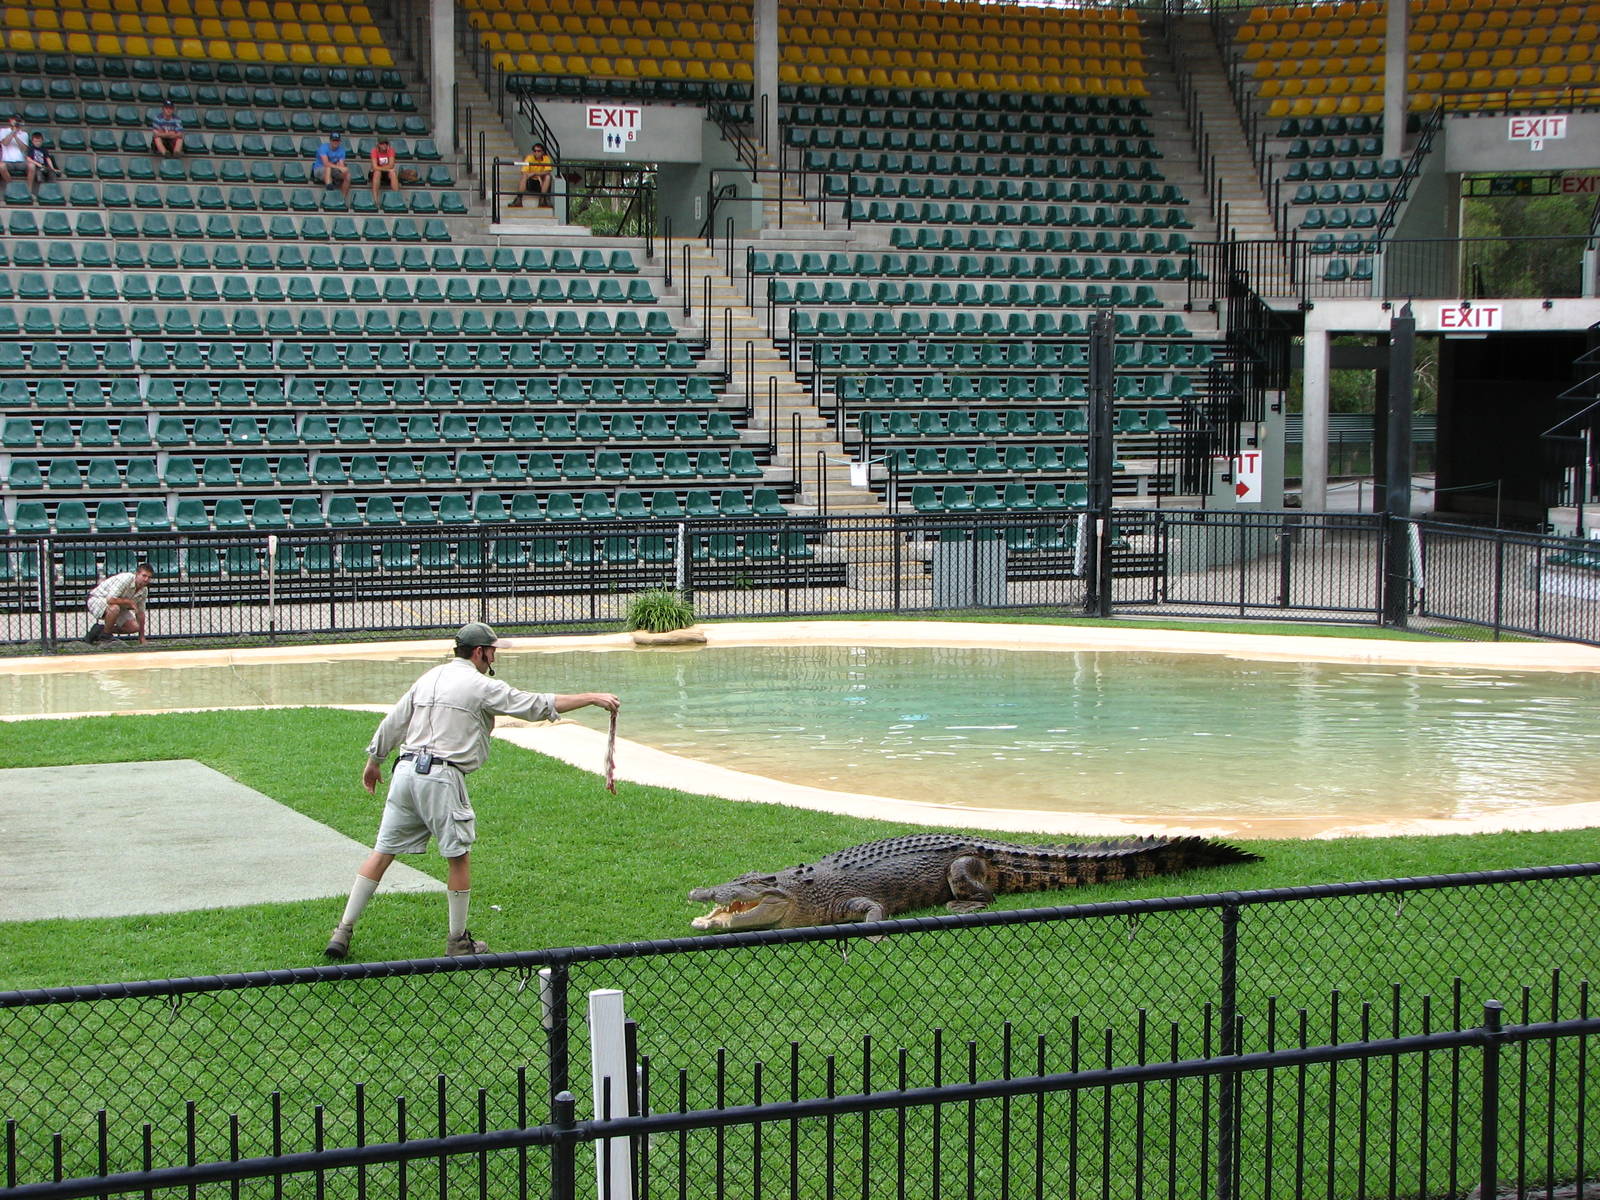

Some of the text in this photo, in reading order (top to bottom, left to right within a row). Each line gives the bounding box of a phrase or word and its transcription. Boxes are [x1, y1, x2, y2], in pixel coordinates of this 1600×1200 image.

[588, 108, 639, 128] EXIT
[627, 131, 634, 140] 6
[1511, 118, 1564, 138] EXIT
[1563, 176, 1600, 193] EXI
[1441, 308, 1499, 327] EXIT
